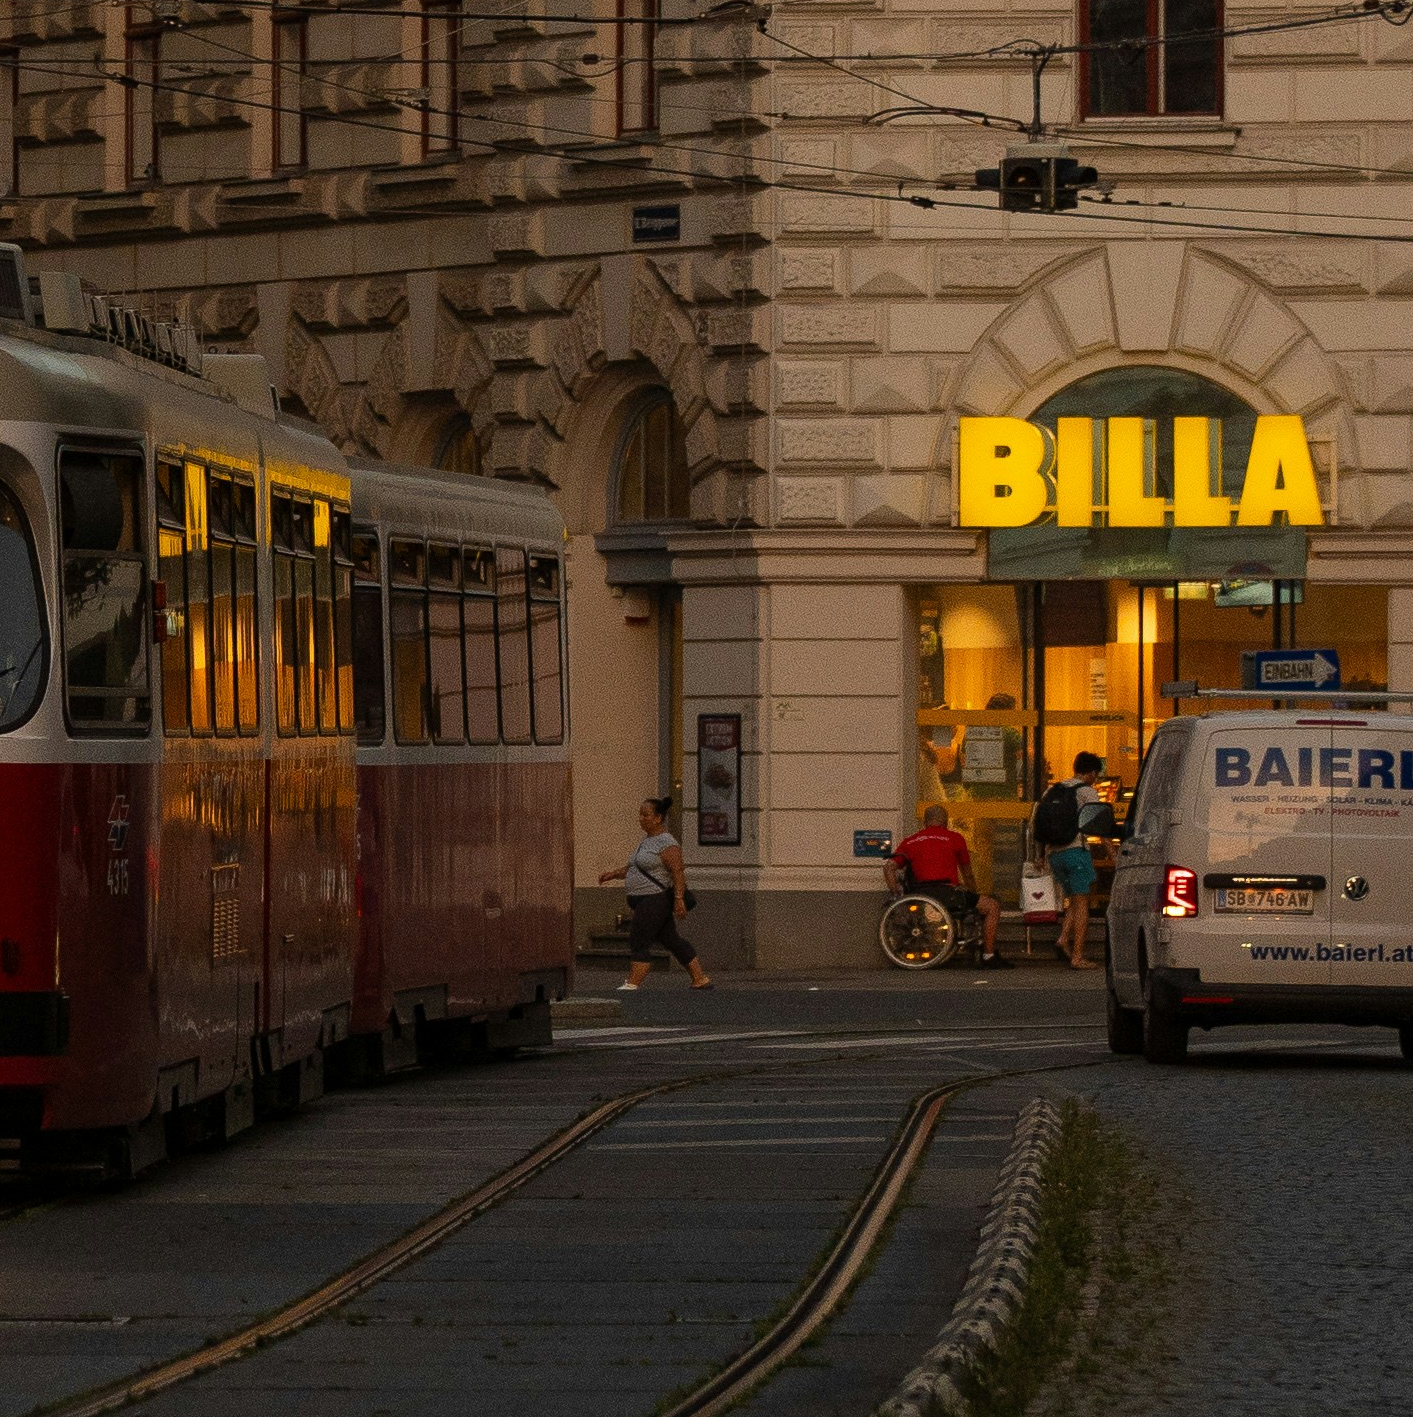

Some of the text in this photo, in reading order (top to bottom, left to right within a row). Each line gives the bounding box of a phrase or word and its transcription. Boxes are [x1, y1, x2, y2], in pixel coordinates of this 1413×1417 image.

[959, 415, 1326, 528] BILLA
[1265, 662, 1313, 680] EINBAHN
[1231, 795, 1270, 803] WASSER
[1277, 795, 1318, 804] HEIZUNG
[1326, 796, 1357, 804] SOLAR
[1264, 807, 1306, 816] ELEKTRO
[107, 858, 129, 895] 4315
[1227, 891, 1309, 907] SB 746 AW
